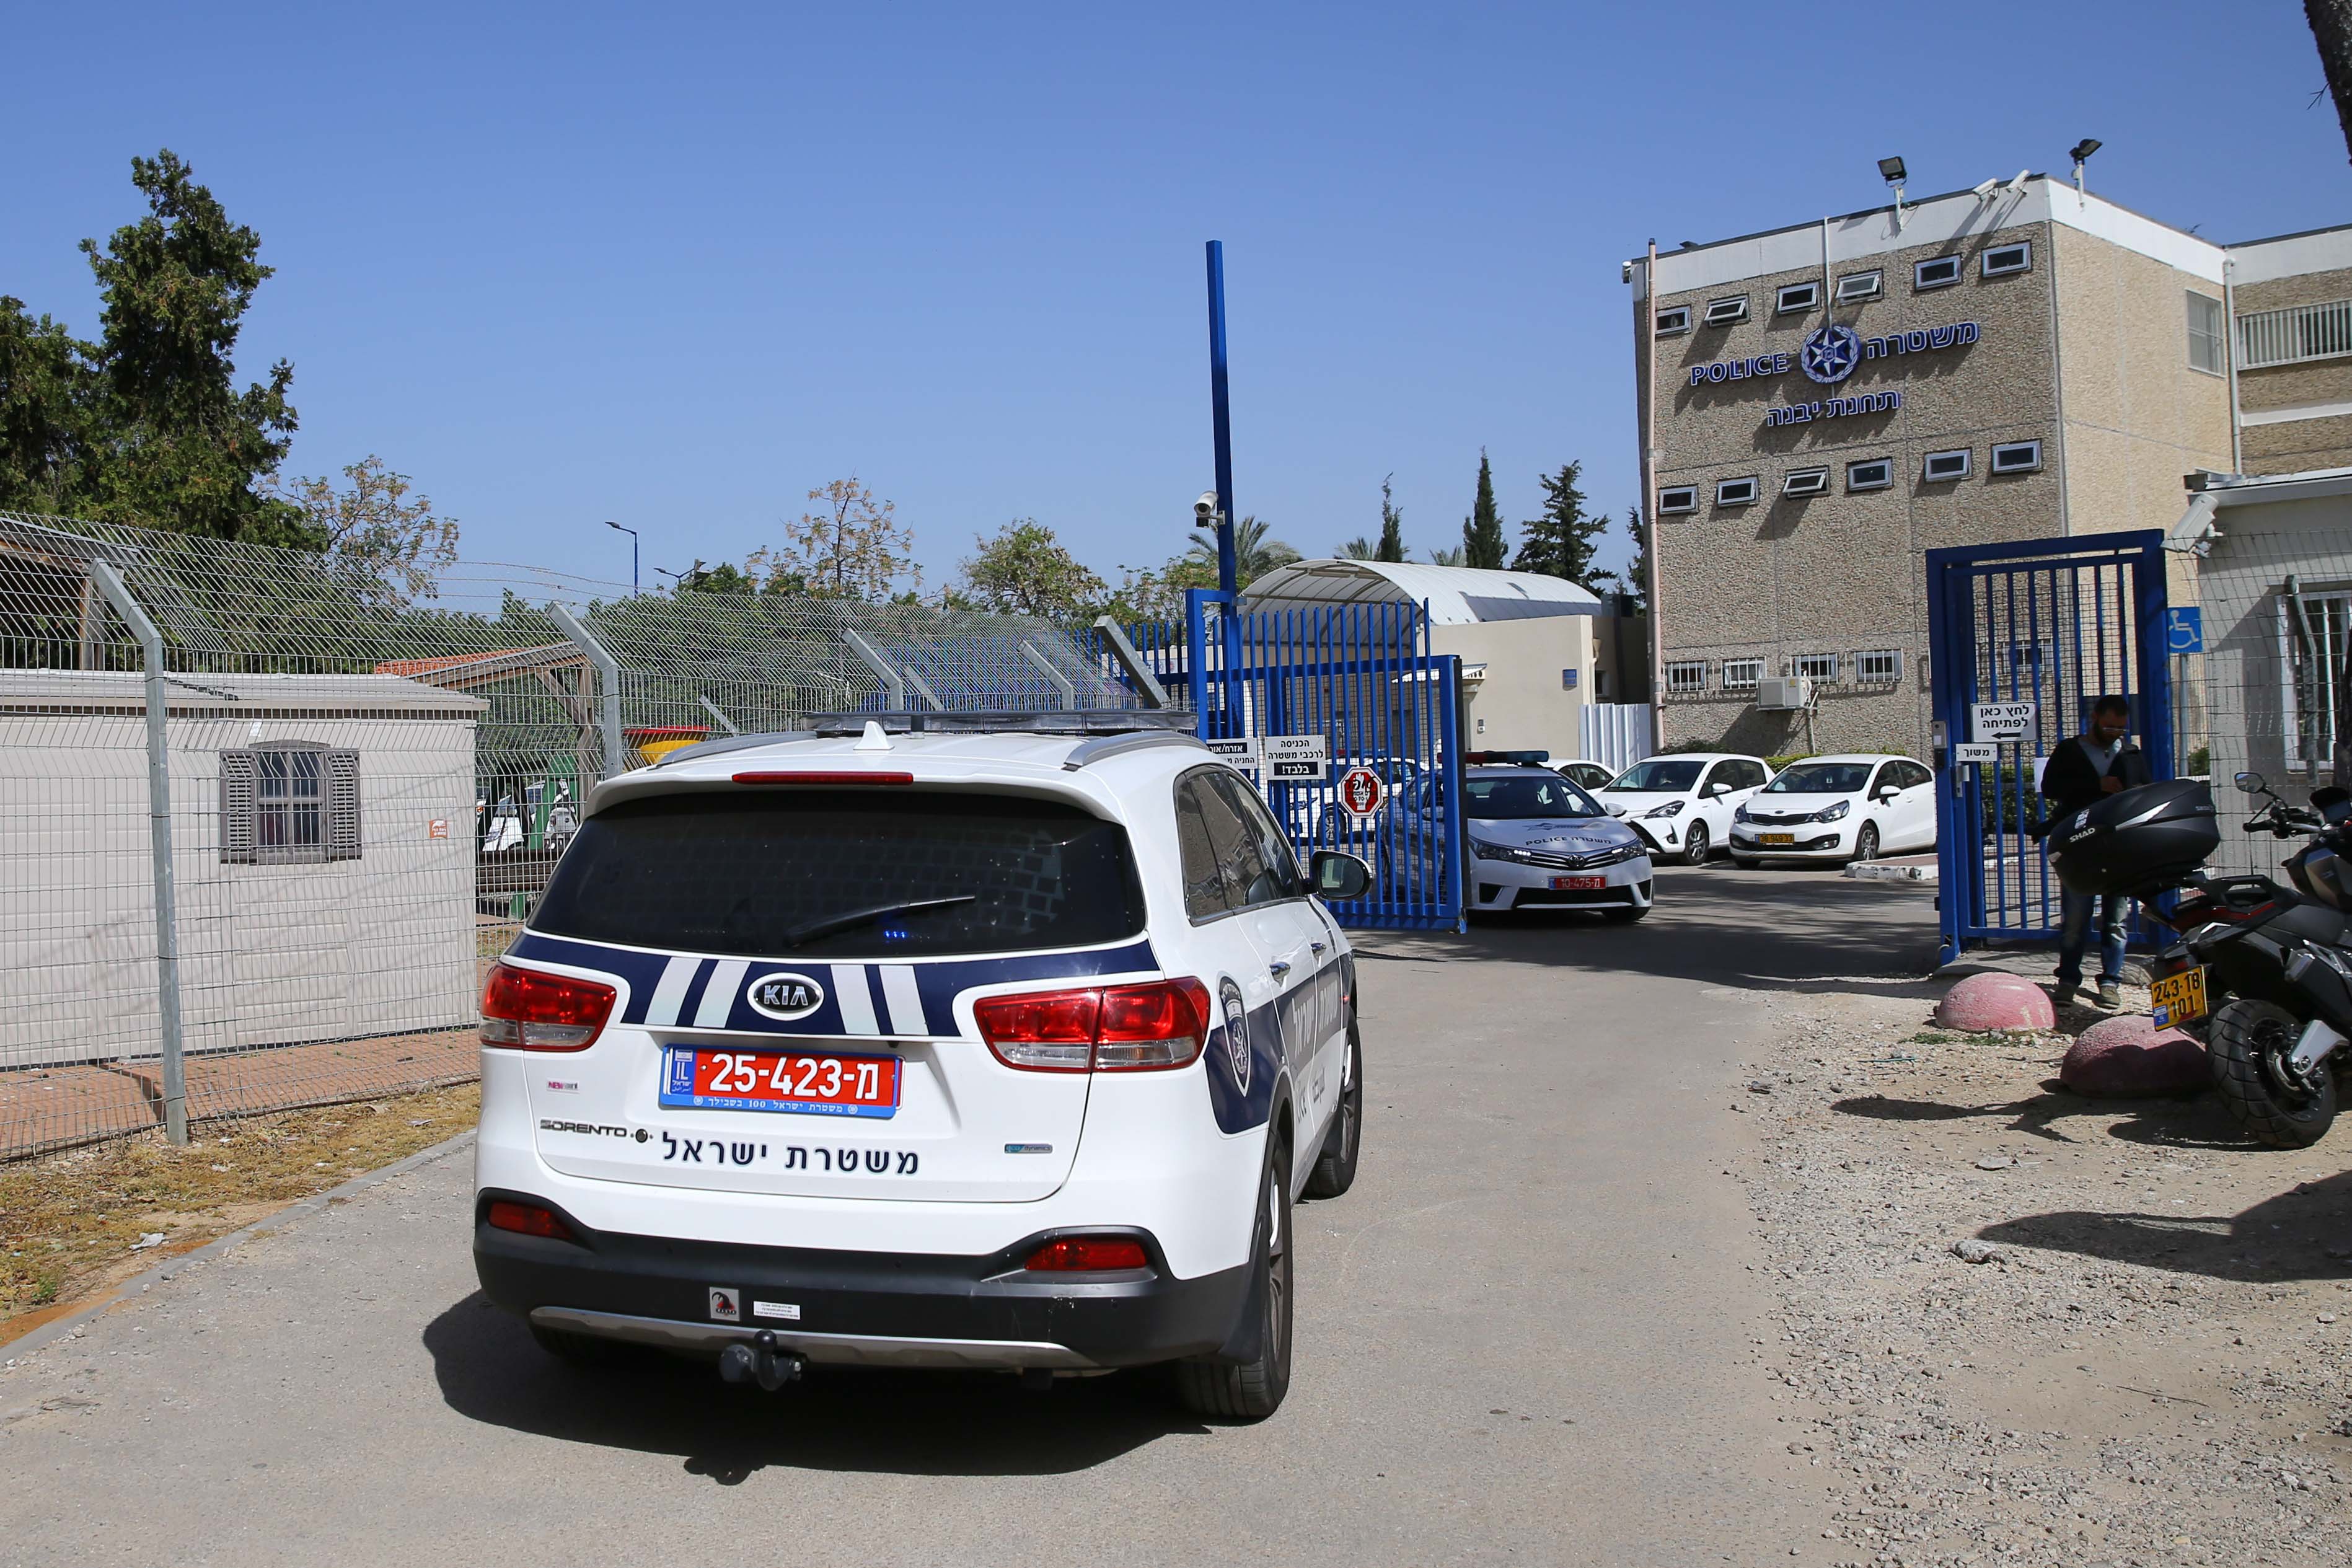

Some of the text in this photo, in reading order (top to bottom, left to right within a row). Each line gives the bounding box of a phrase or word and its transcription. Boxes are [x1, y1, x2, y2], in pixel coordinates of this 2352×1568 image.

[1867, 322, 1980, 359] משטרה
[1691, 351, 1788, 386] POLICE
[1767, 390, 1901, 427] תחנת יבנה
[1980, 705, 2029, 718] לחץ כאן
[1983, 717, 2028, 728] לפתיחה
[1280, 739, 1310, 747] הכניסה
[1299, 749, 1323, 759] לרכבי
[1963, 749, 1989, 757] משוך
[1282, 764, 1310, 775] בלבד!
[1525, 837, 1567, 845] POLICE
[2069, 827, 2095, 843] SHAD
[2154, 972, 2201, 1003] 243-18
[764, 985, 809, 1006] KIA
[2170, 995, 2196, 1017] 101
[676, 1062, 689, 1080] IL
[749, 1100, 766, 1108] 100
[773, 1100, 804, 1110] ישראל
[808, 1104, 843, 1113] משטרת
[540, 1119, 627, 1138] SORENTO
[663, 1131, 919, 1175] משטרת ישראל
